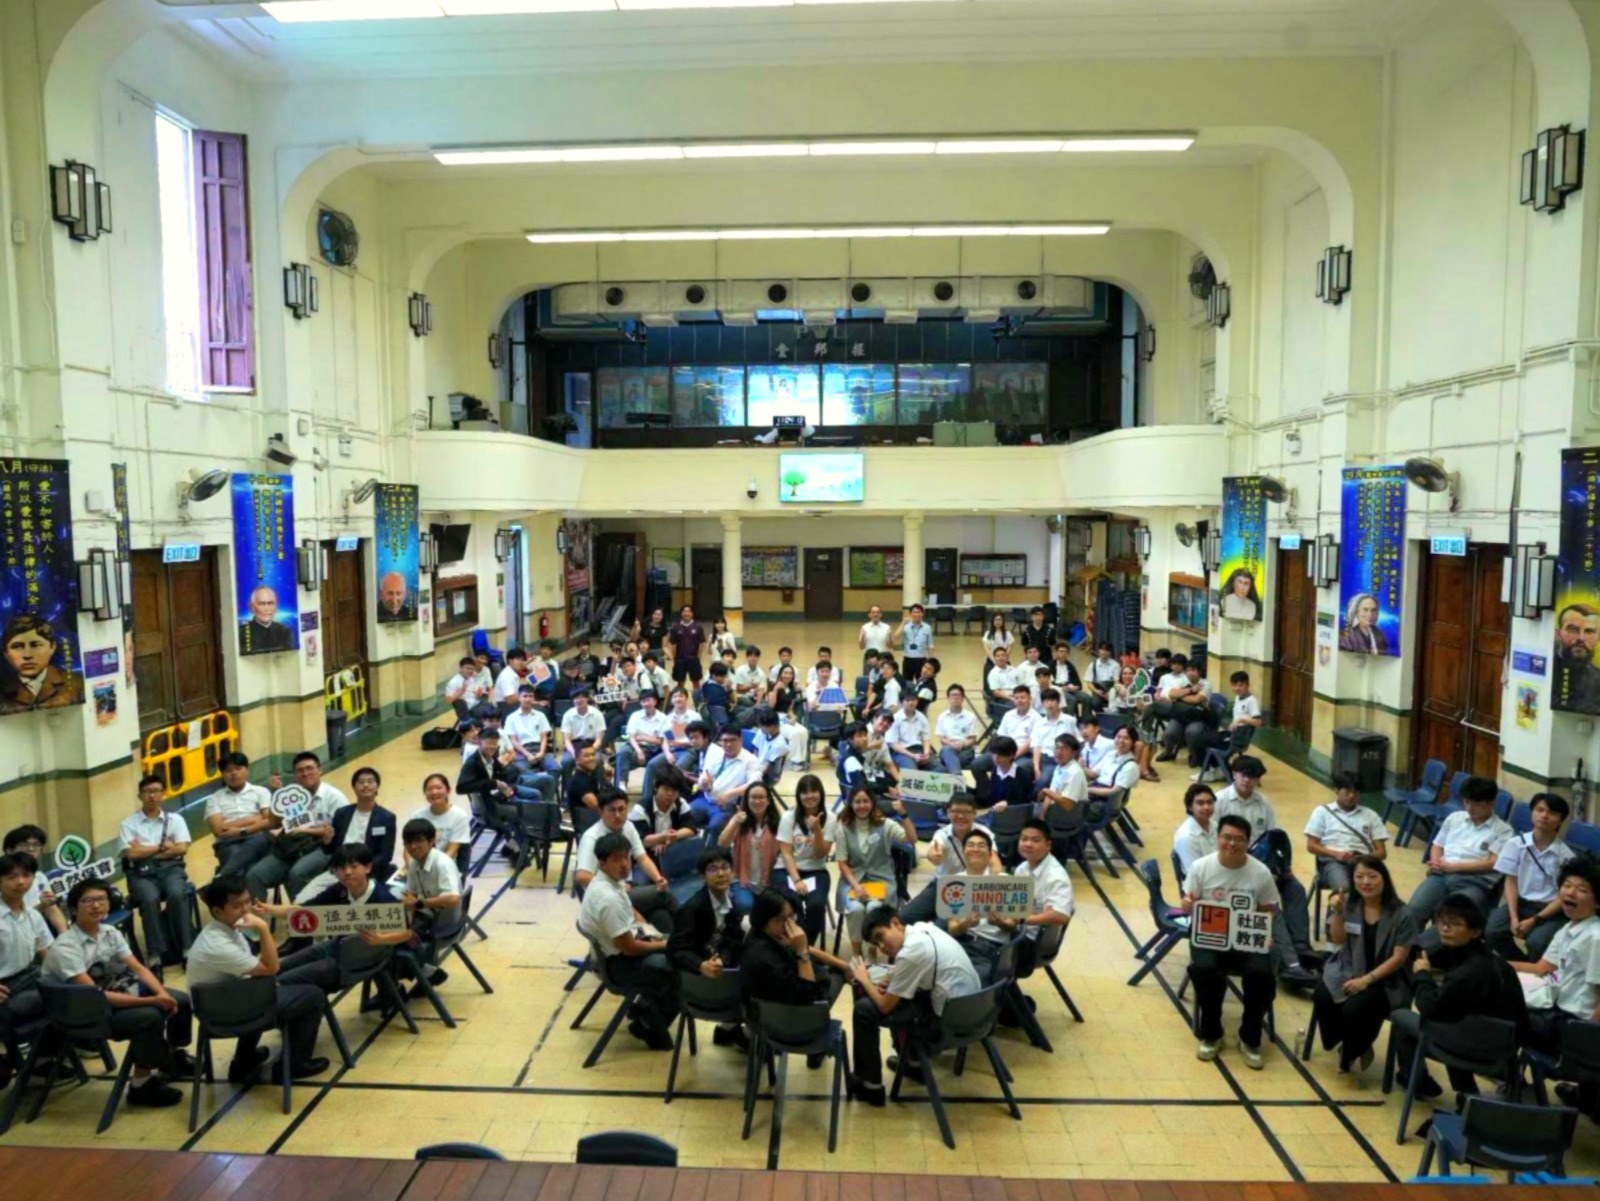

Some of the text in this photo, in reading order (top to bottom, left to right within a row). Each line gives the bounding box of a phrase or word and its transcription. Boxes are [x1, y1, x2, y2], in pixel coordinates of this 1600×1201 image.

[166, 546, 197, 561] EXIT 出口
[1433, 539, 1463, 554] EXIT 出口
[50, 860, 112, 894] 自然保育
[971, 882, 1029, 892] CARBONCARE
[971, 891, 1028, 904] INNOLAB
[323, 907, 401, 922] 恒生銀行
[1237, 913, 1269, 931] 社區
[326, 923, 351, 932] HANG
[379, 922, 403, 930] BANK
[1236, 930, 1267, 948] 教育
